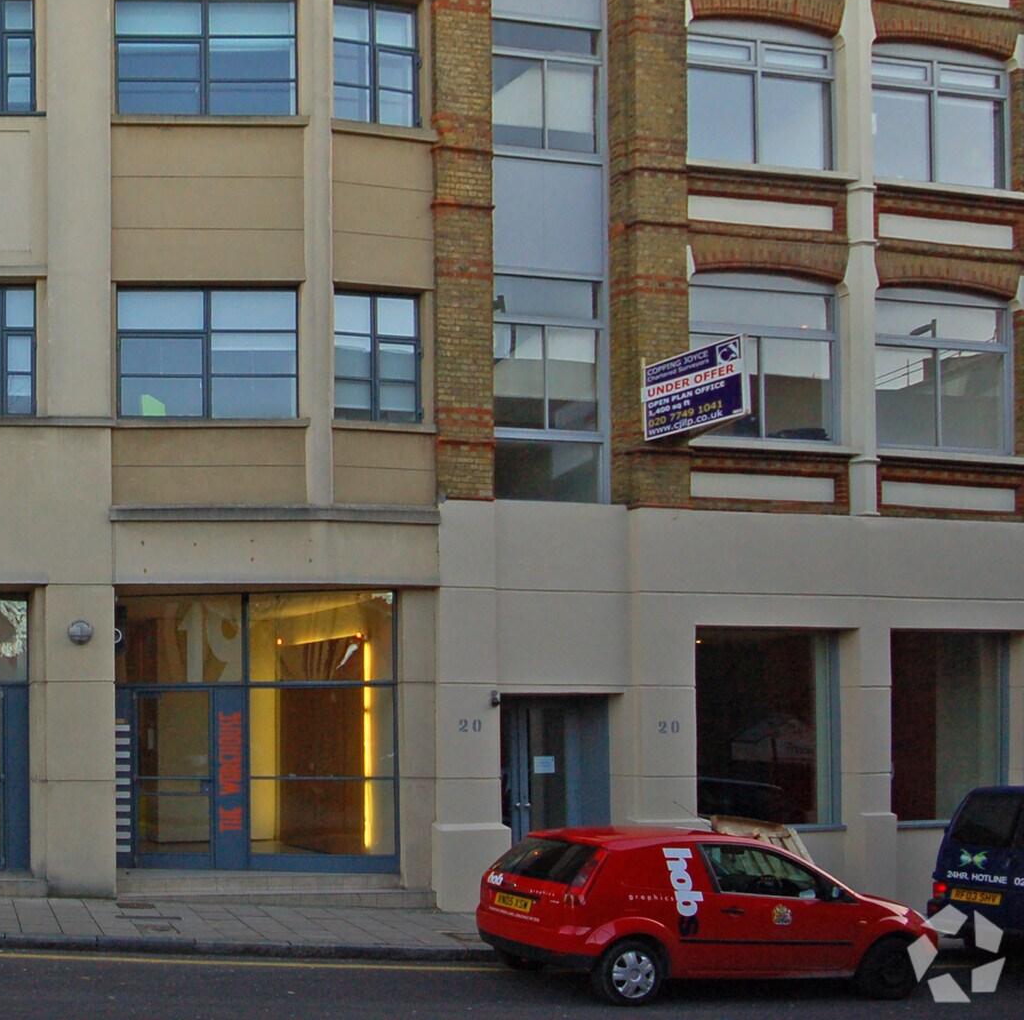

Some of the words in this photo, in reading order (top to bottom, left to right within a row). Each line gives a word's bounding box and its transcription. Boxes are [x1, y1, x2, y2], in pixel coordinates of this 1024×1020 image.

[647, 359, 682, 376] COPPING
[683, 350, 709, 365] JOYCE
[647, 369, 677, 383] Chartered
[678, 358, 710, 373] Surveyors
[647, 377, 689, 397] UNDER
[693, 364, 734, 384] OFFER
[648, 397, 670, 409] OPEN
[671, 391, 693, 402] PLAN
[695, 381, 725, 395] OFFICE
[648, 406, 670, 417] 1,400
[672, 402, 682, 410] sq
[683, 399, 691, 407] ft
[648, 416, 667, 428] 020
[670, 408, 694, 421] 7749
[698, 400, 723, 414] 1041
[177, 600, 242, 682] 19
[458, 718, 482, 733] 20
[658, 720, 680, 734] 20
[218, 711, 243, 797] WAREHOUSE
[218, 805, 243, 833] THE
[971, 873, 1008, 885] HOTLINE
[529, 888, 555, 898] graphics
[628, 893, 675, 902] graphics
[954, 889, 977, 902] RF03
[978, 892, 998, 904] SHV
